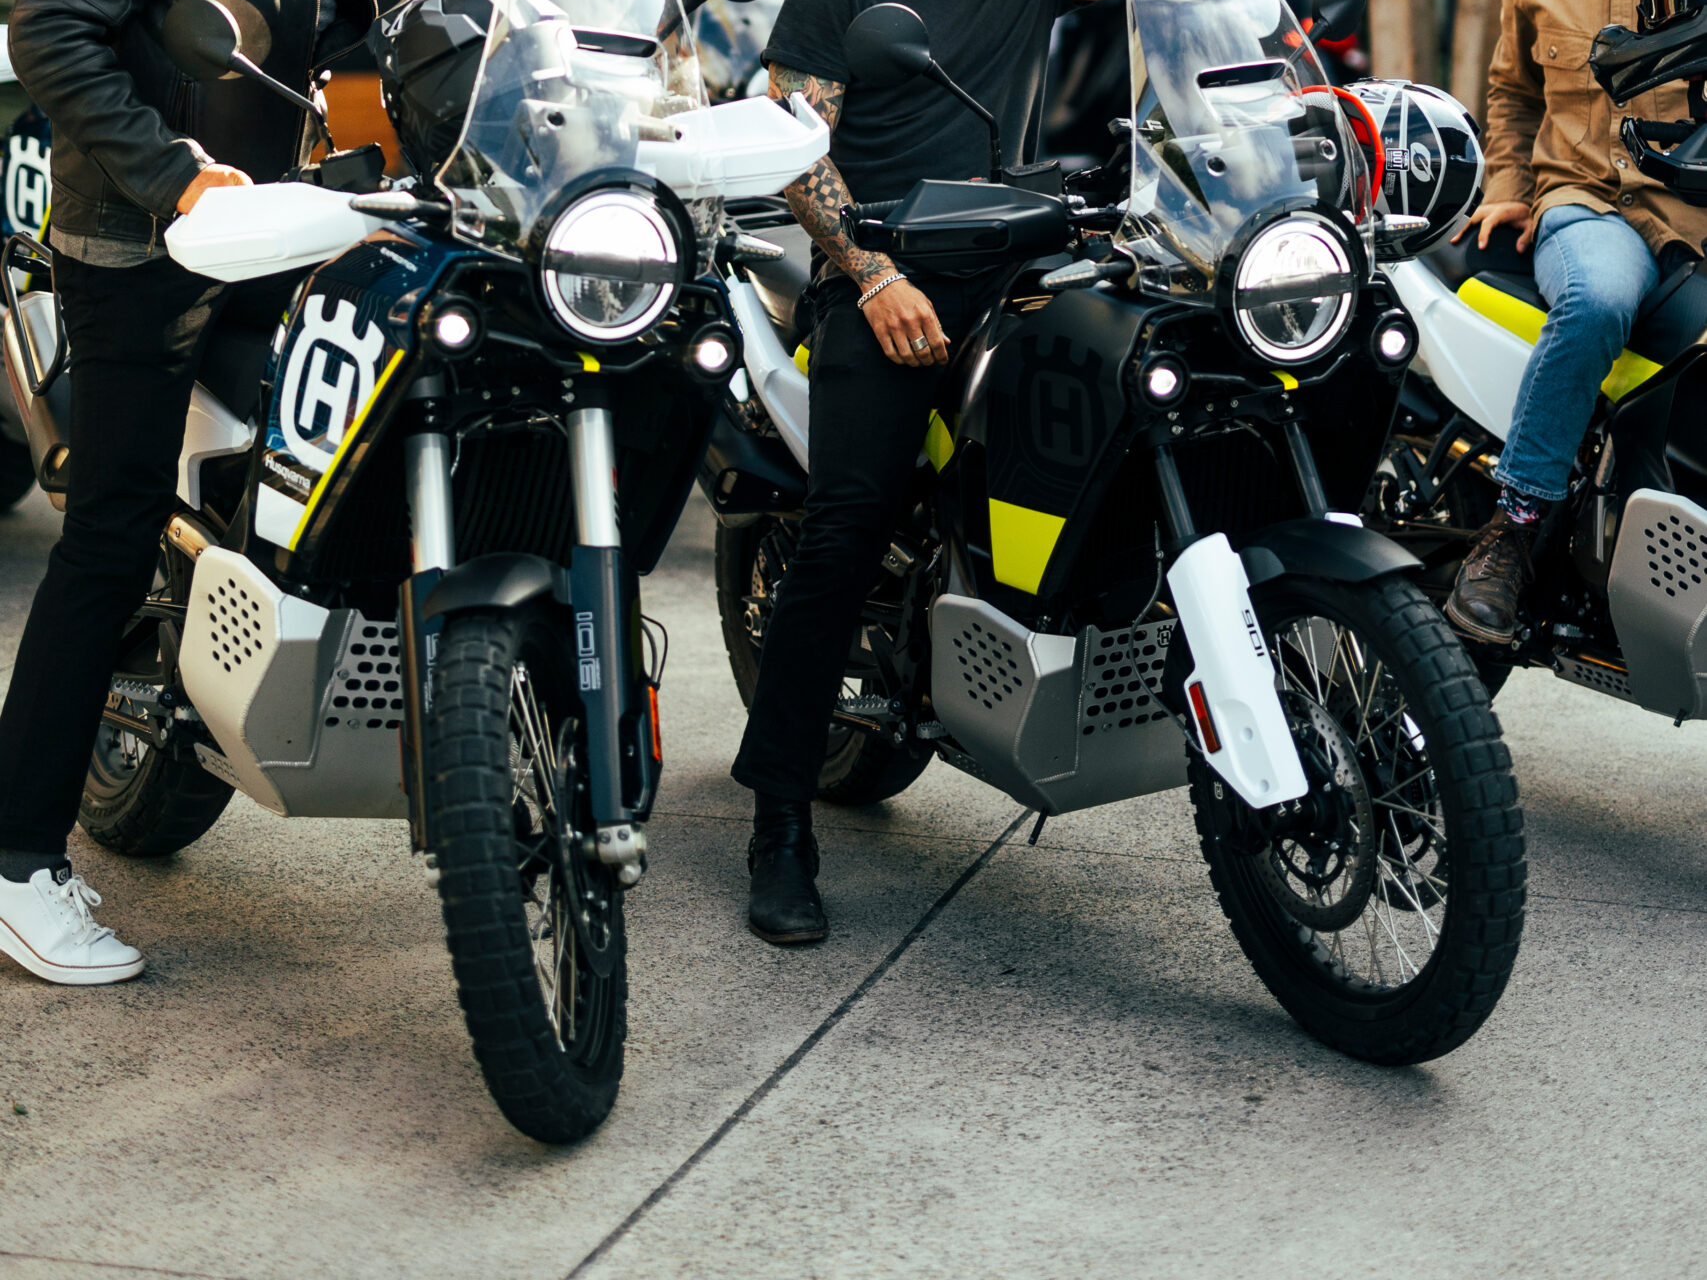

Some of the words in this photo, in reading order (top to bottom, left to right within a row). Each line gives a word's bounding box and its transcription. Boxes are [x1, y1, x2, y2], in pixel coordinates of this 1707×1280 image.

[1393, 150, 1403, 169] DOT
[265, 454, 311, 489] Husqvarna
[576, 612, 596, 691] 901
[1241, 609, 1265, 657] 901
